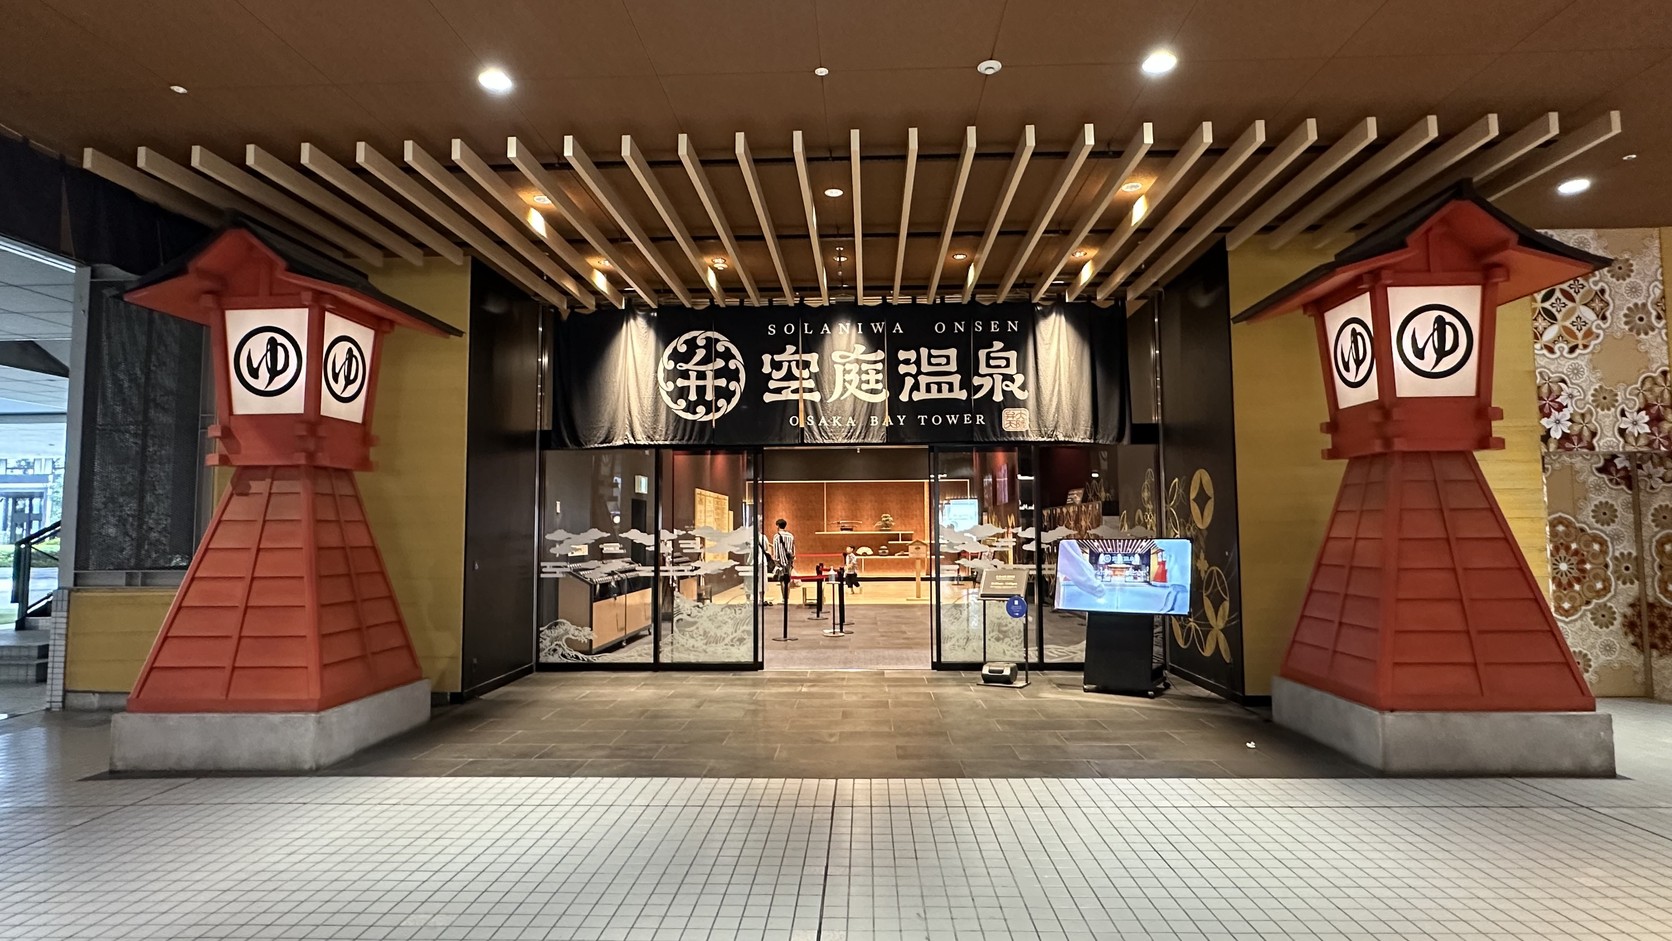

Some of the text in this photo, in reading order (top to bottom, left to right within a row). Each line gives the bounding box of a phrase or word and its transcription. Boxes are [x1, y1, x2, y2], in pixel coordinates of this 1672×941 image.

[767, 320, 1019, 336] SOLANIWA ONSEN
[1341, 327, 1367, 380] ゆ
[1411, 315, 1459, 371] ゆ
[246, 336, 289, 389] ゆ
[331, 347, 359, 395] ゆ
[761, 341, 1029, 402] 空庭温泉
[789, 413, 986, 427] OSAKA BAY TOWER
